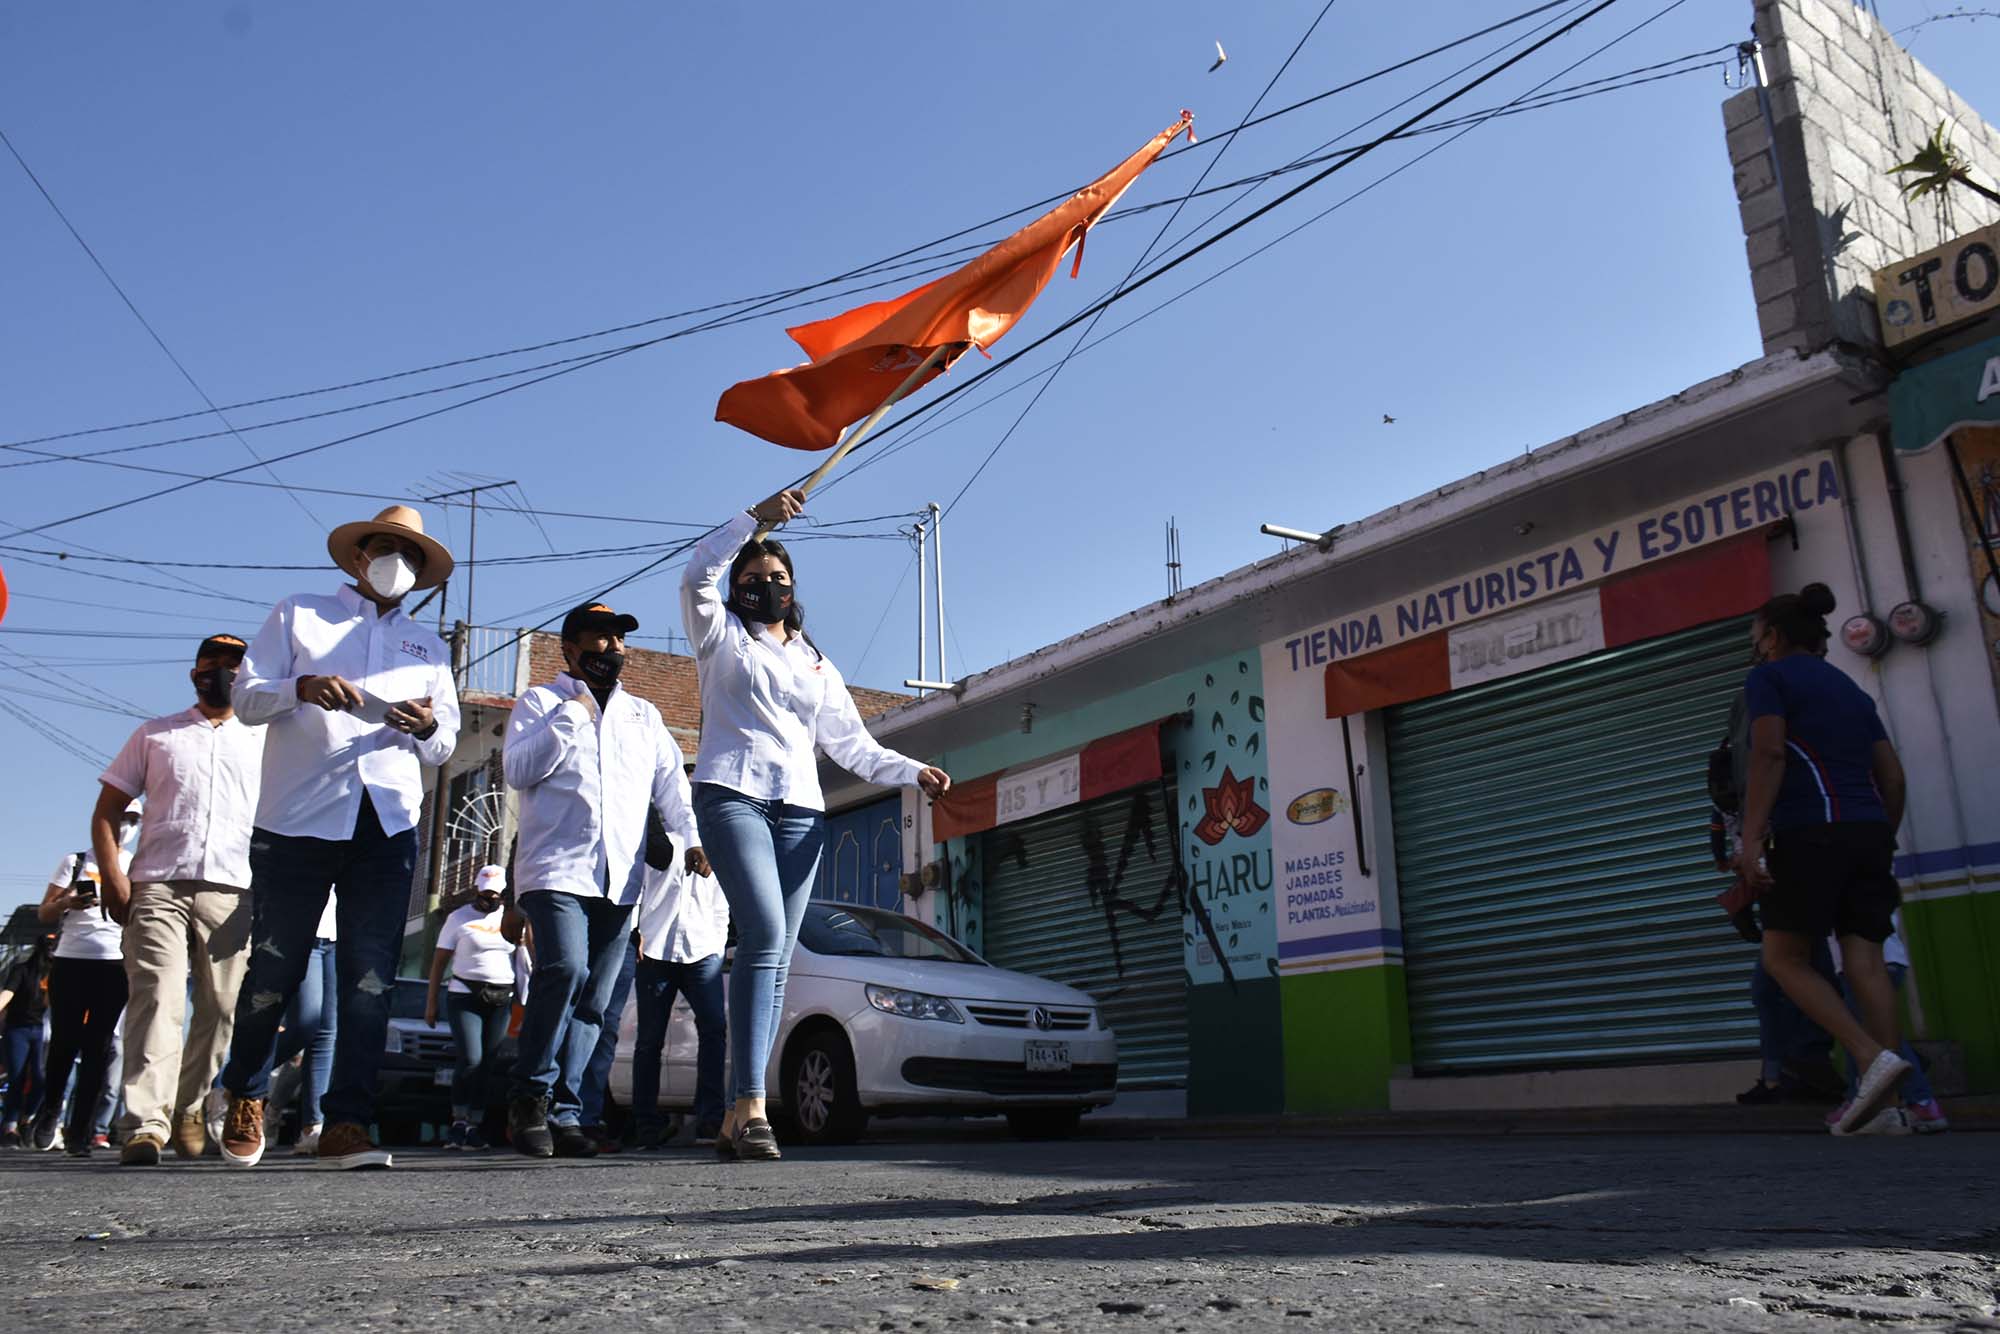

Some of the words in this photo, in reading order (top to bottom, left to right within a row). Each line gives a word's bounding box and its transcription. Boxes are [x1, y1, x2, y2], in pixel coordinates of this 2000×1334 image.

[1285, 614, 1384, 671] TIENDA
[1396, 545, 1585, 638] NATURISTA
[1594, 531, 1620, 573] Y
[1638, 459, 1840, 560] ESOTERICA
[999, 783, 1026, 815] AS
[1191, 848, 1274, 901] HARU
[1285, 851, 1345, 875] MASAJES
[1286, 869, 1343, 890] JARABES
[1288, 886, 1345, 909] POMADAS
